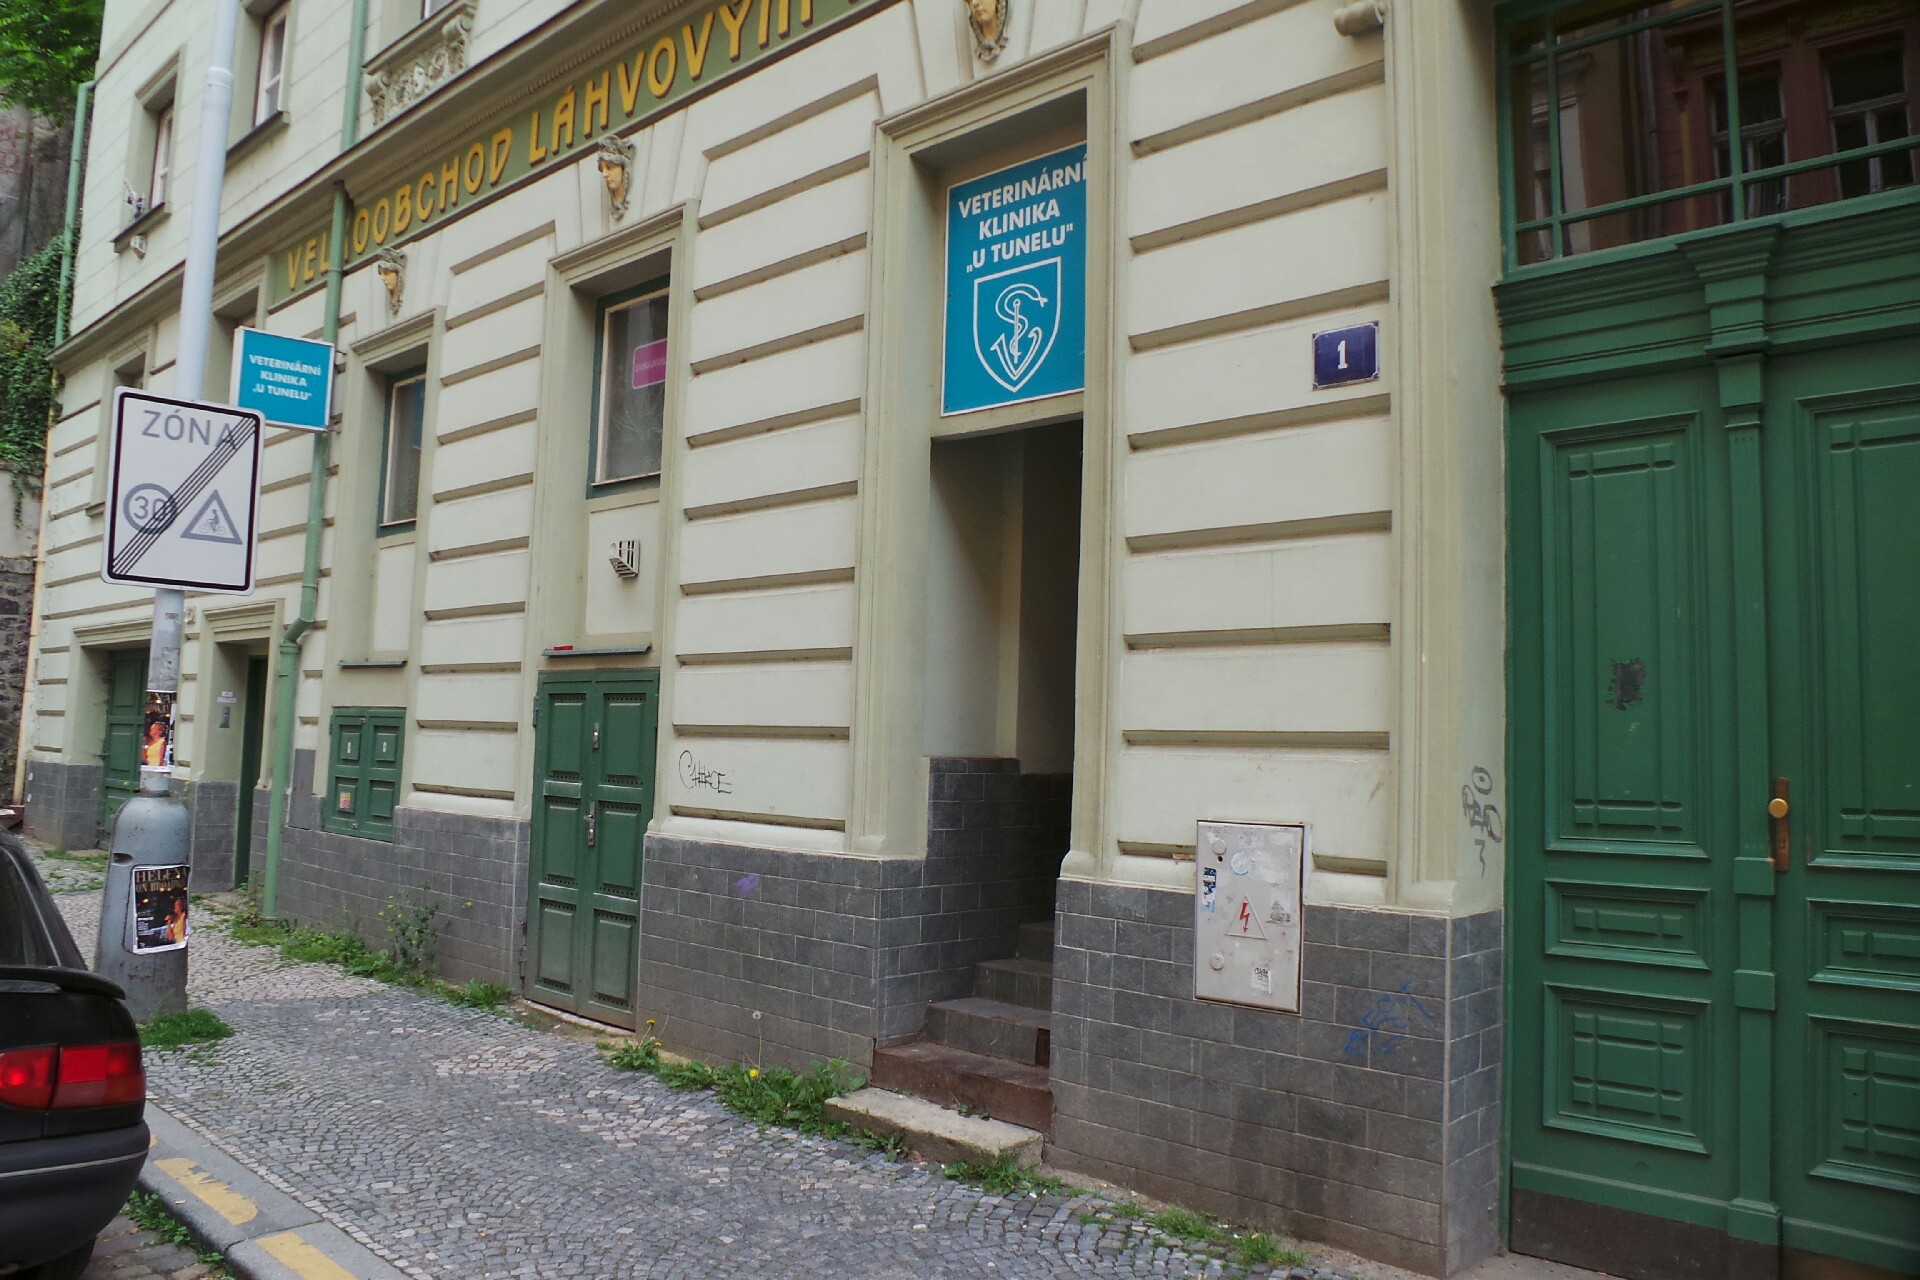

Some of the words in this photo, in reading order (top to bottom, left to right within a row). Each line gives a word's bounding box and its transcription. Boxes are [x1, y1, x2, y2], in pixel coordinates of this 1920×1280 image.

[958, 153, 1087, 218] VETERINÁRNÍ
[287, 127, 513, 291] VELOOBCHOD
[979, 198, 1060, 240] KLINIKA
[249, 354, 322, 376] VETERINÁRNÍ
[1337, 339, 1349, 370] 1
[260, 370, 307, 387] KLINIKA
[142, 409, 238, 450] ZÓNA
[133, 495, 169, 521] 30
